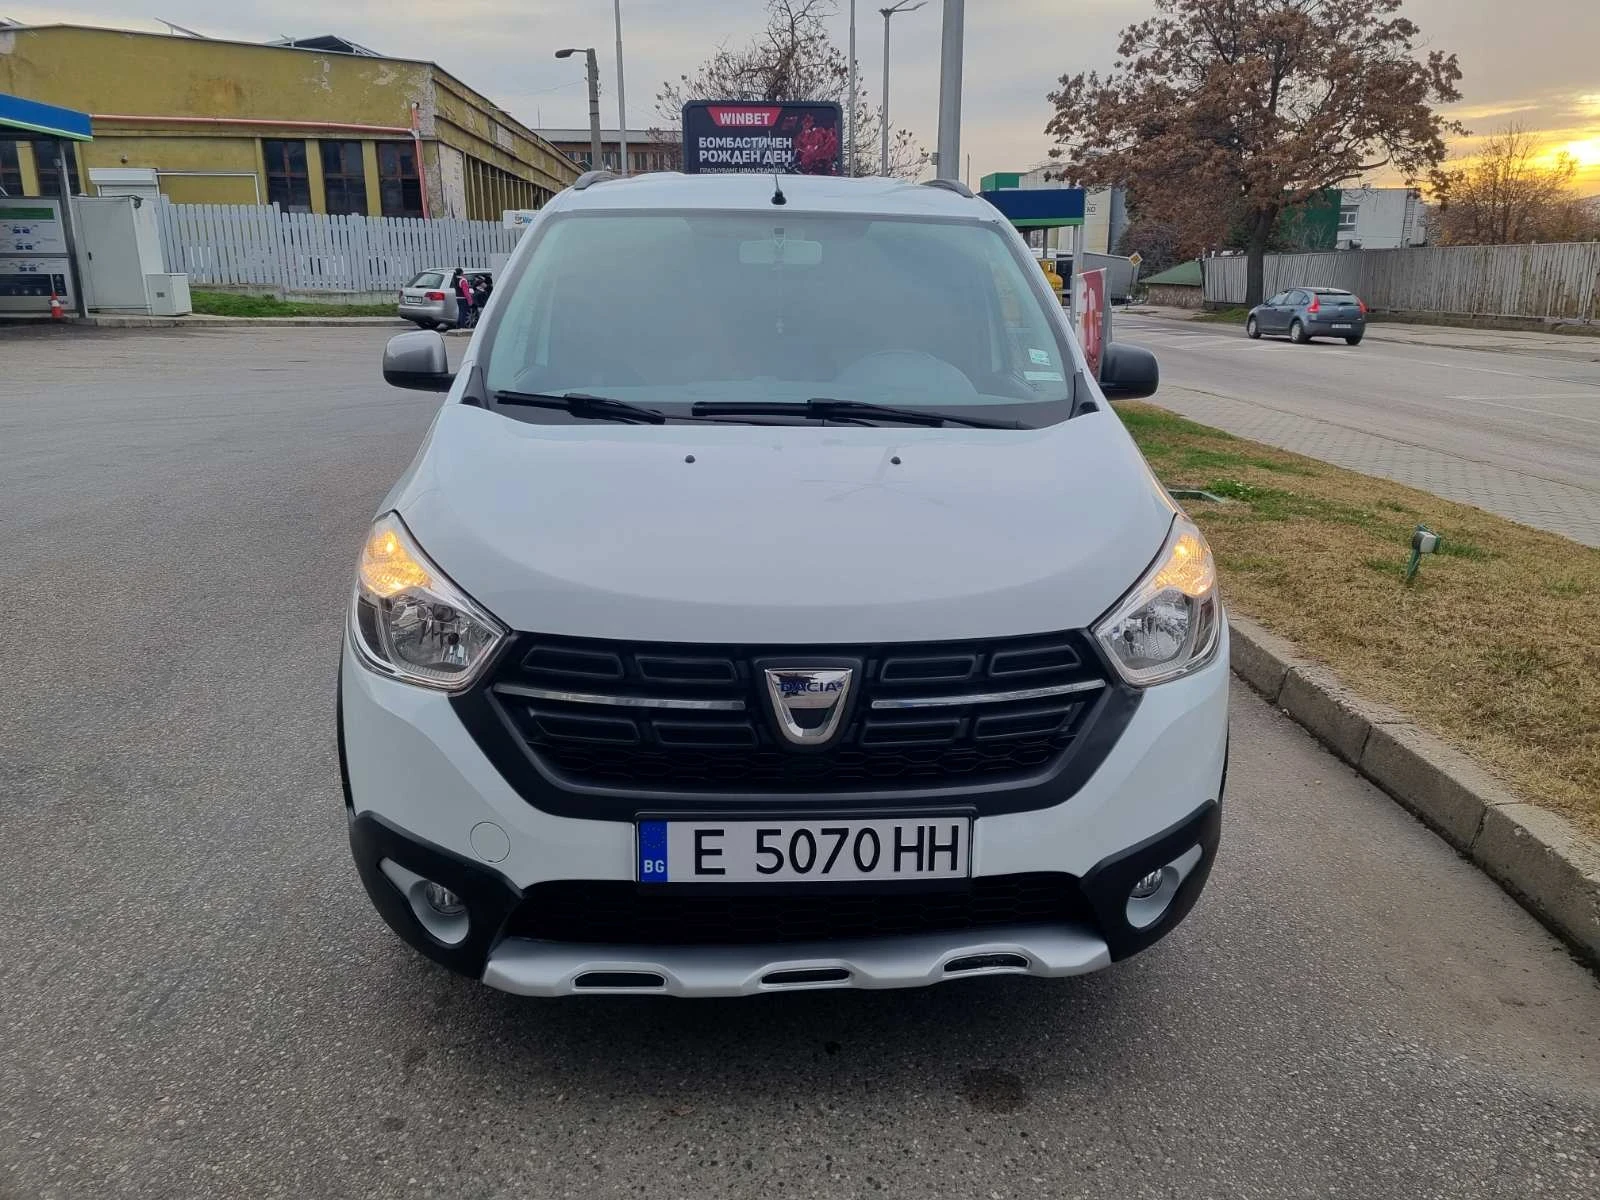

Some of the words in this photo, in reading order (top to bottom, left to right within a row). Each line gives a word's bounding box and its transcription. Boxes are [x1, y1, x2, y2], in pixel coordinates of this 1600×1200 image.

[720, 112, 770, 125] WINBET
[698, 136, 792, 149] БОМБАСТИЧЕН
[699, 150, 761, 165] РОЖДЕН
[762, 150, 792, 165] ДЕН
[780, 681, 838, 693] DACIA
[694, 829, 726, 875] E
[756, 826, 882, 875] 5070
[893, 825, 959, 873] HH
[643, 859, 665, 874] BG
